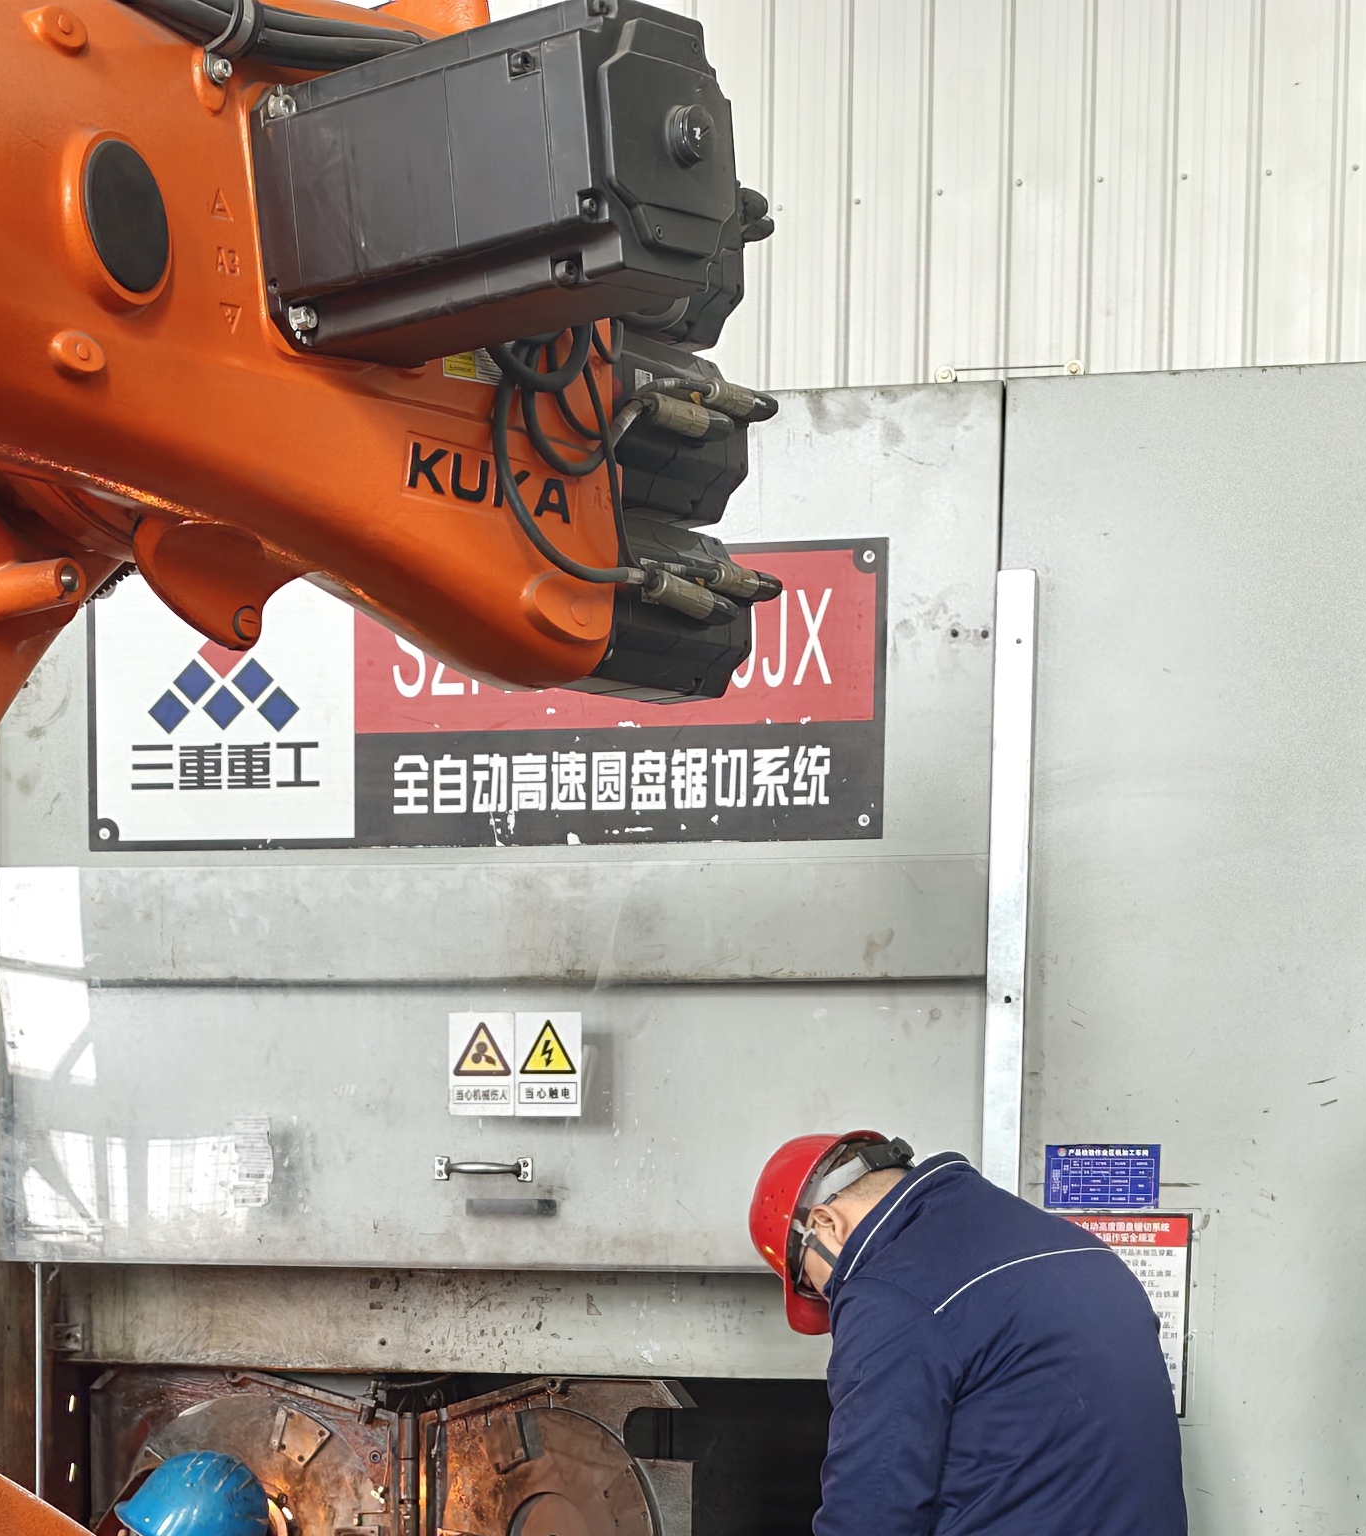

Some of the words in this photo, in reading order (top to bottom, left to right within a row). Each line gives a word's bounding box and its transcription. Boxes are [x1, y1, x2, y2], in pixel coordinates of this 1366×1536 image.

[408, 441, 571, 524] KUKA
[131, 741, 321, 791] 三重重工
[392, 744, 832, 815] 全自动高速圆盘锯切系统
[455, 1089, 508, 1102] 当心机械伤人
[524, 1086, 572, 1100] 当心触电
